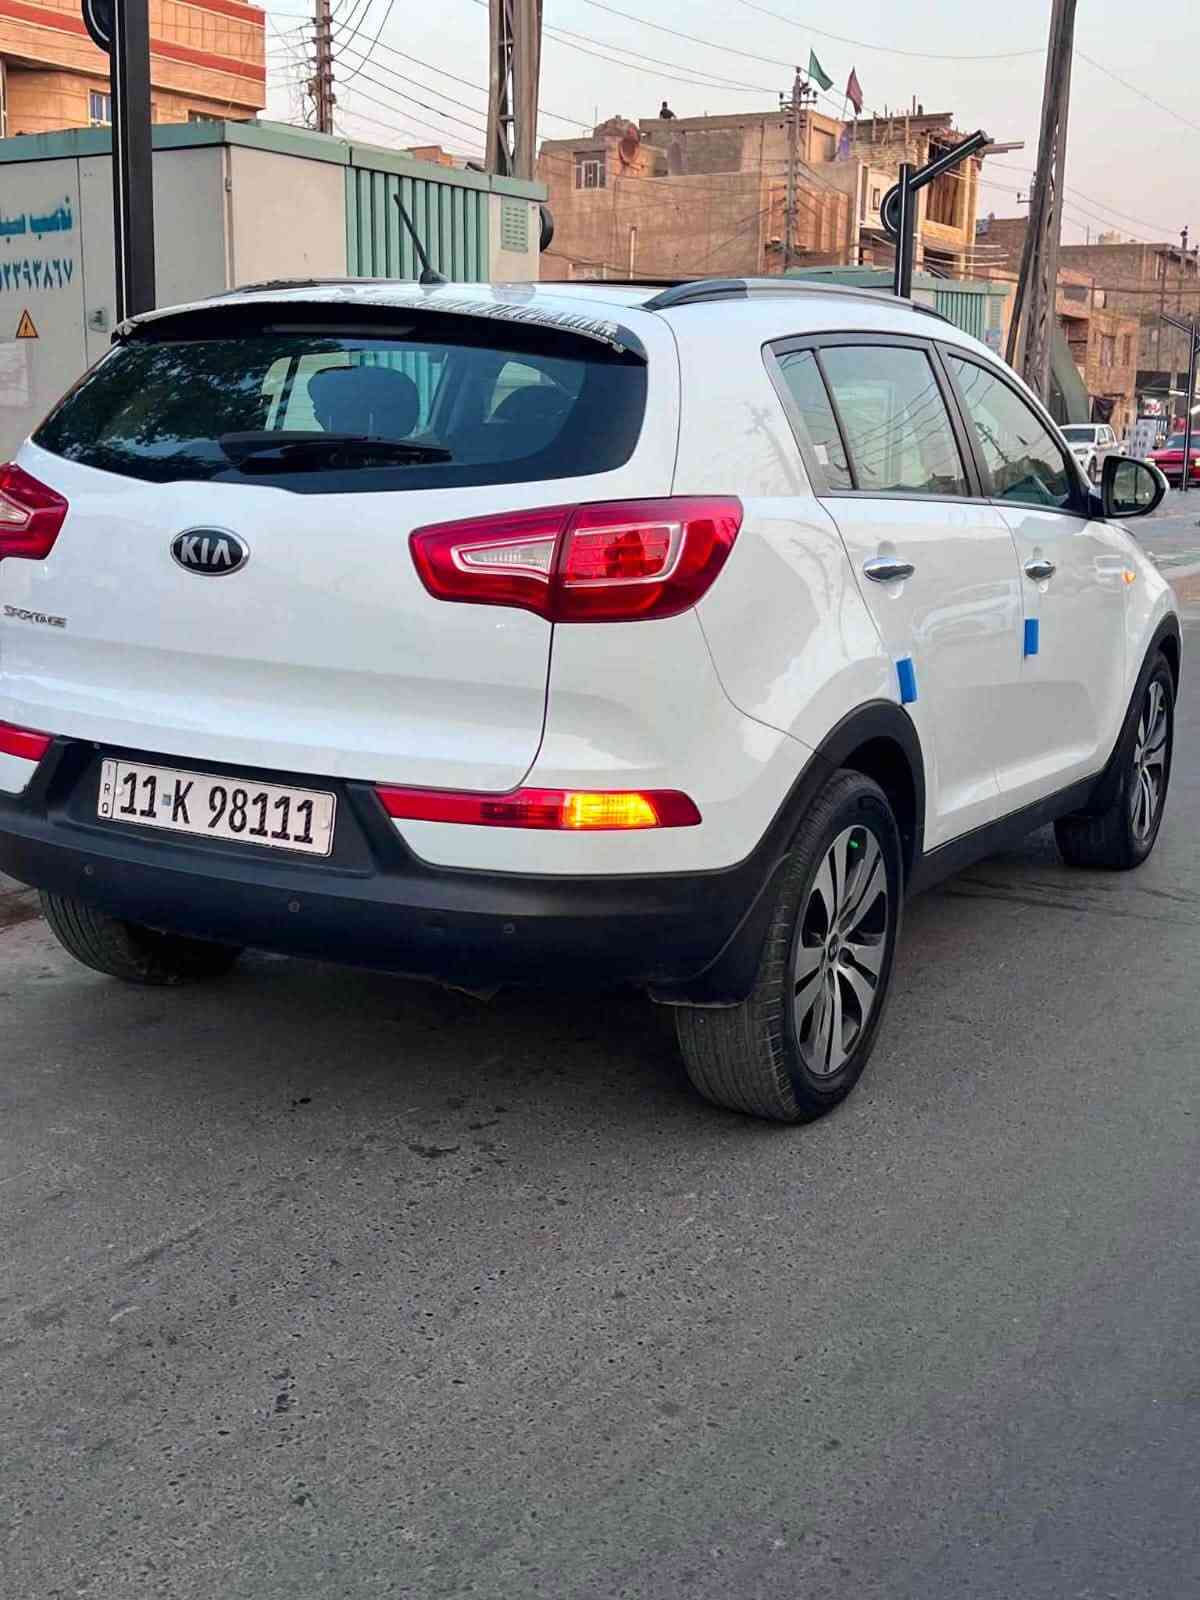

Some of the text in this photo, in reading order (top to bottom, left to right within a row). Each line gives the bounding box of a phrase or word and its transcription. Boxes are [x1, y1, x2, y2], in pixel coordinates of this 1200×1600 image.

[181, 535, 232, 566] KIA
[120, 772, 314, 844] 11 K 98111
